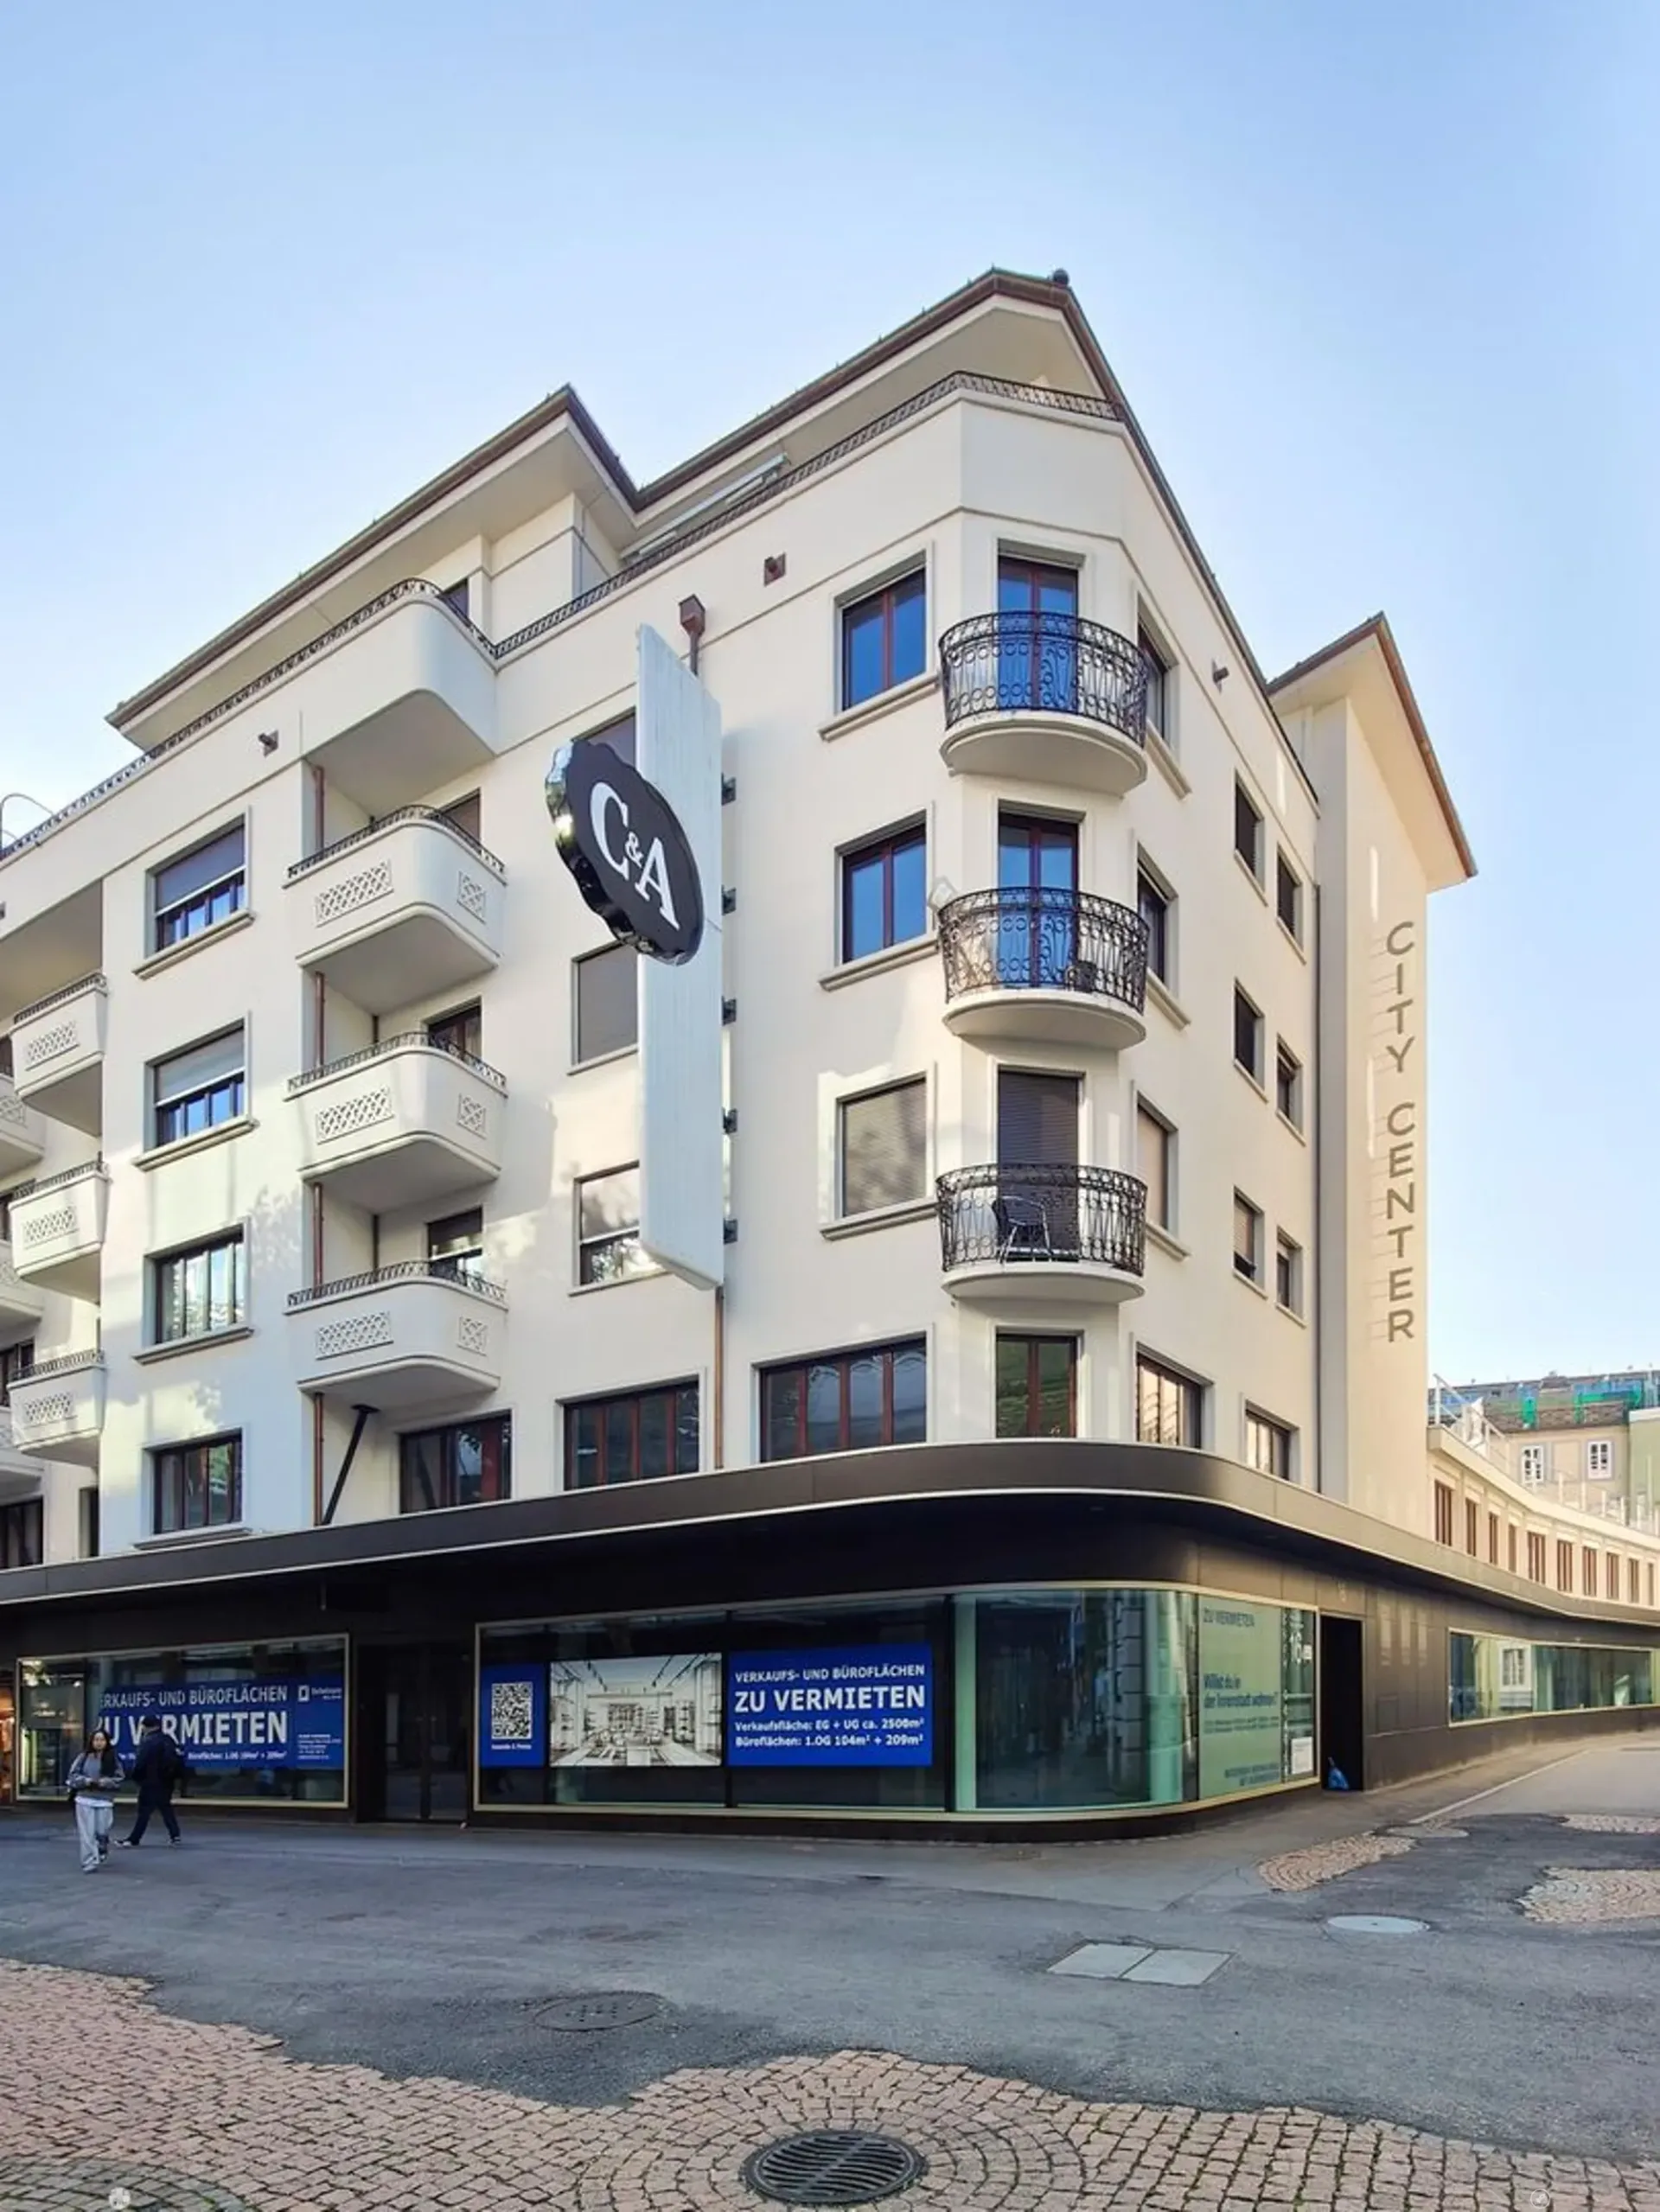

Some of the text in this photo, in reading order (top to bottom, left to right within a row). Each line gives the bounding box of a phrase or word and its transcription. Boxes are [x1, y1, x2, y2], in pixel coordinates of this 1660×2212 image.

[590, 781, 681, 931] C&A
[1385, 921, 1416, 1343] CITY CENTER
[735, 1663, 925, 1683] VERKAUFS- UND BÜROFLÄCHEN
[158, 1689, 185, 1706] UND
[189, 1685, 288, 1705] BÜROFLÄCHEN
[734, 1684, 925, 1713] ZU VERMIETEN
[128, 1711, 287, 1746] VRMIETEN
[814, 1719, 830, 1731] EG
[844, 1718, 859, 1730] UG
[862, 1719, 878, 1730] ca.
